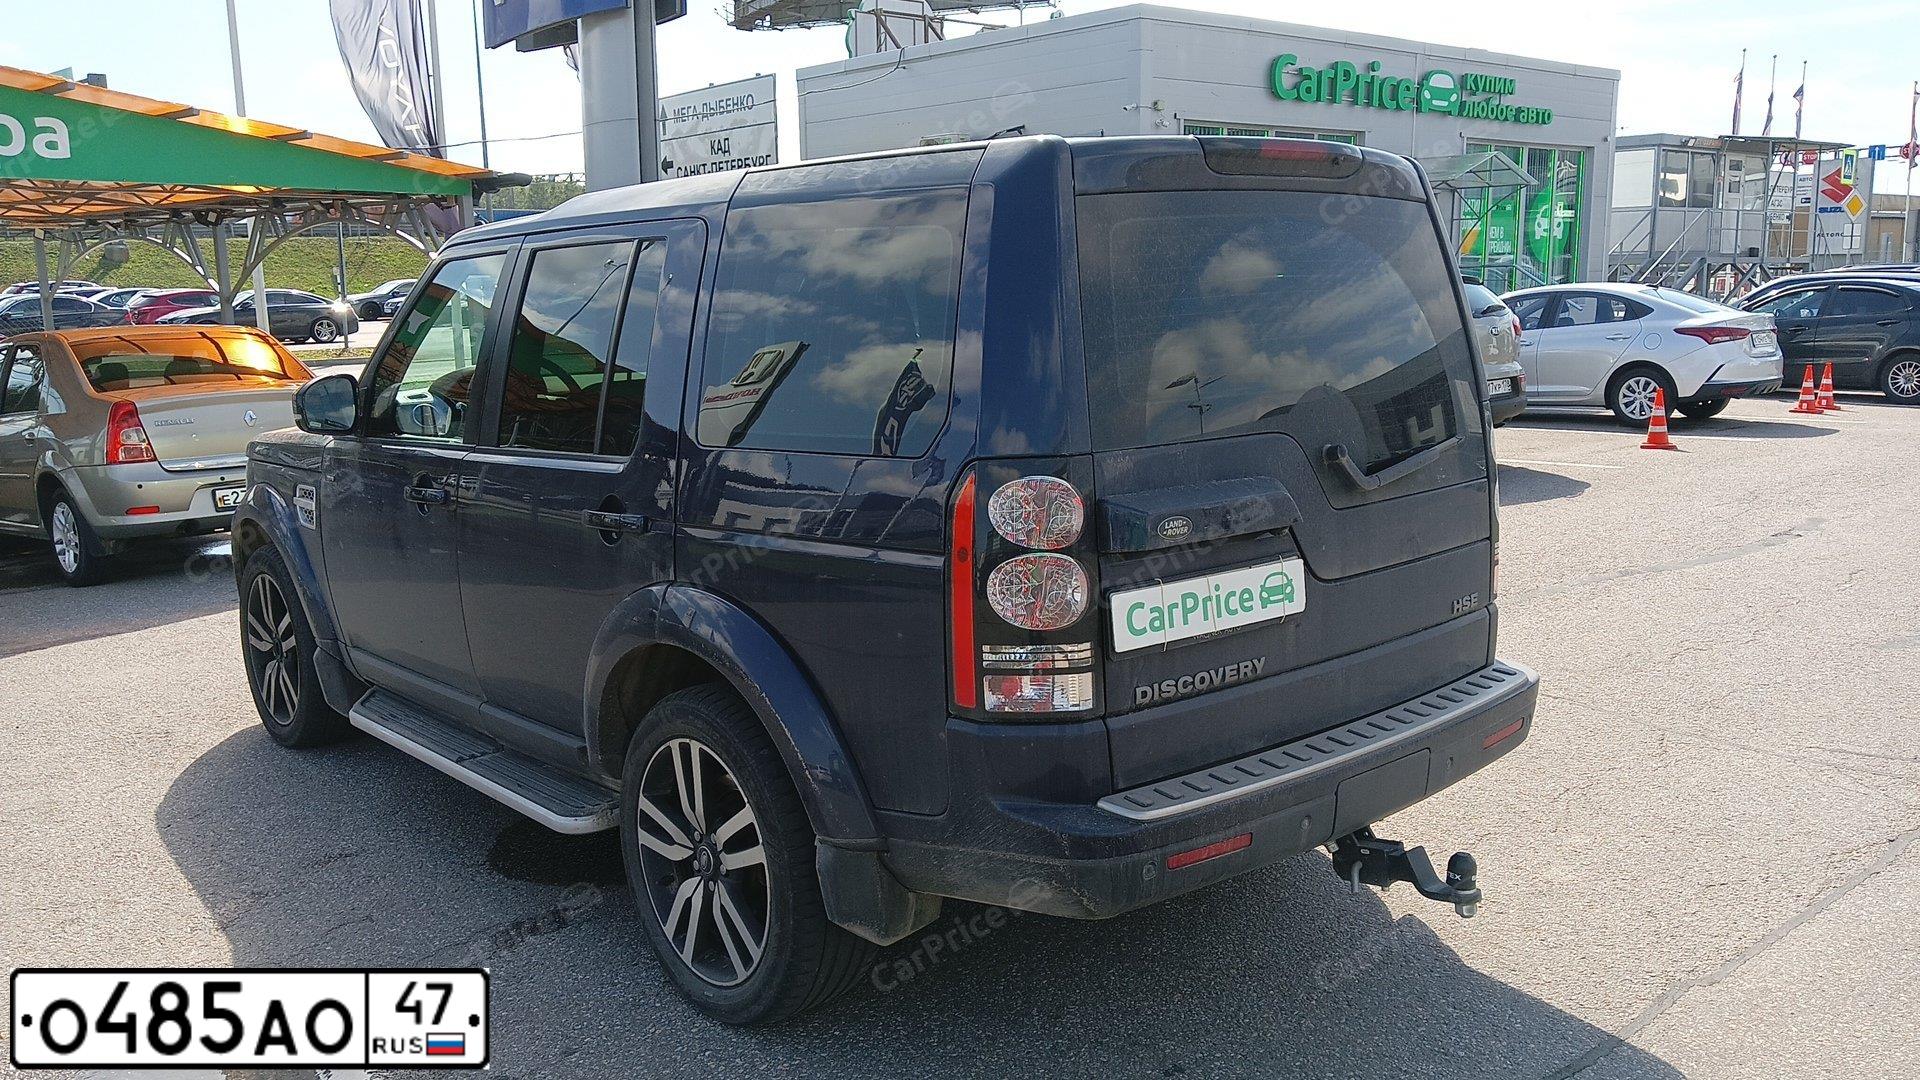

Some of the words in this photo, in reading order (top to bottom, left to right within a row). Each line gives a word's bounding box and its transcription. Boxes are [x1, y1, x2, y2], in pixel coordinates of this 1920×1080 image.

[1270, 53, 1415, 112] CarPrice
[1464, 72, 1516, 97] купим
[673, 105, 699, 124] МЕГА
[701, 94, 754, 122] ДЫБЕНКО
[1462, 96, 1516, 123] любое
[1519, 107, 1554, 126] авто
[710, 137, 731, 157] КАД
[677, 154, 771, 178] САНКТ-ПЕТЕРБУРГ
[154, 417, 196, 427] RENAULT
[1165, 519, 1184, 529] LAND
[1166, 527, 1189, 536] ROVER
[1126, 583, 1254, 637] CarPrice
[1452, 592, 1479, 615] HSE
[1135, 657, 1266, 705] DISCOVERY
